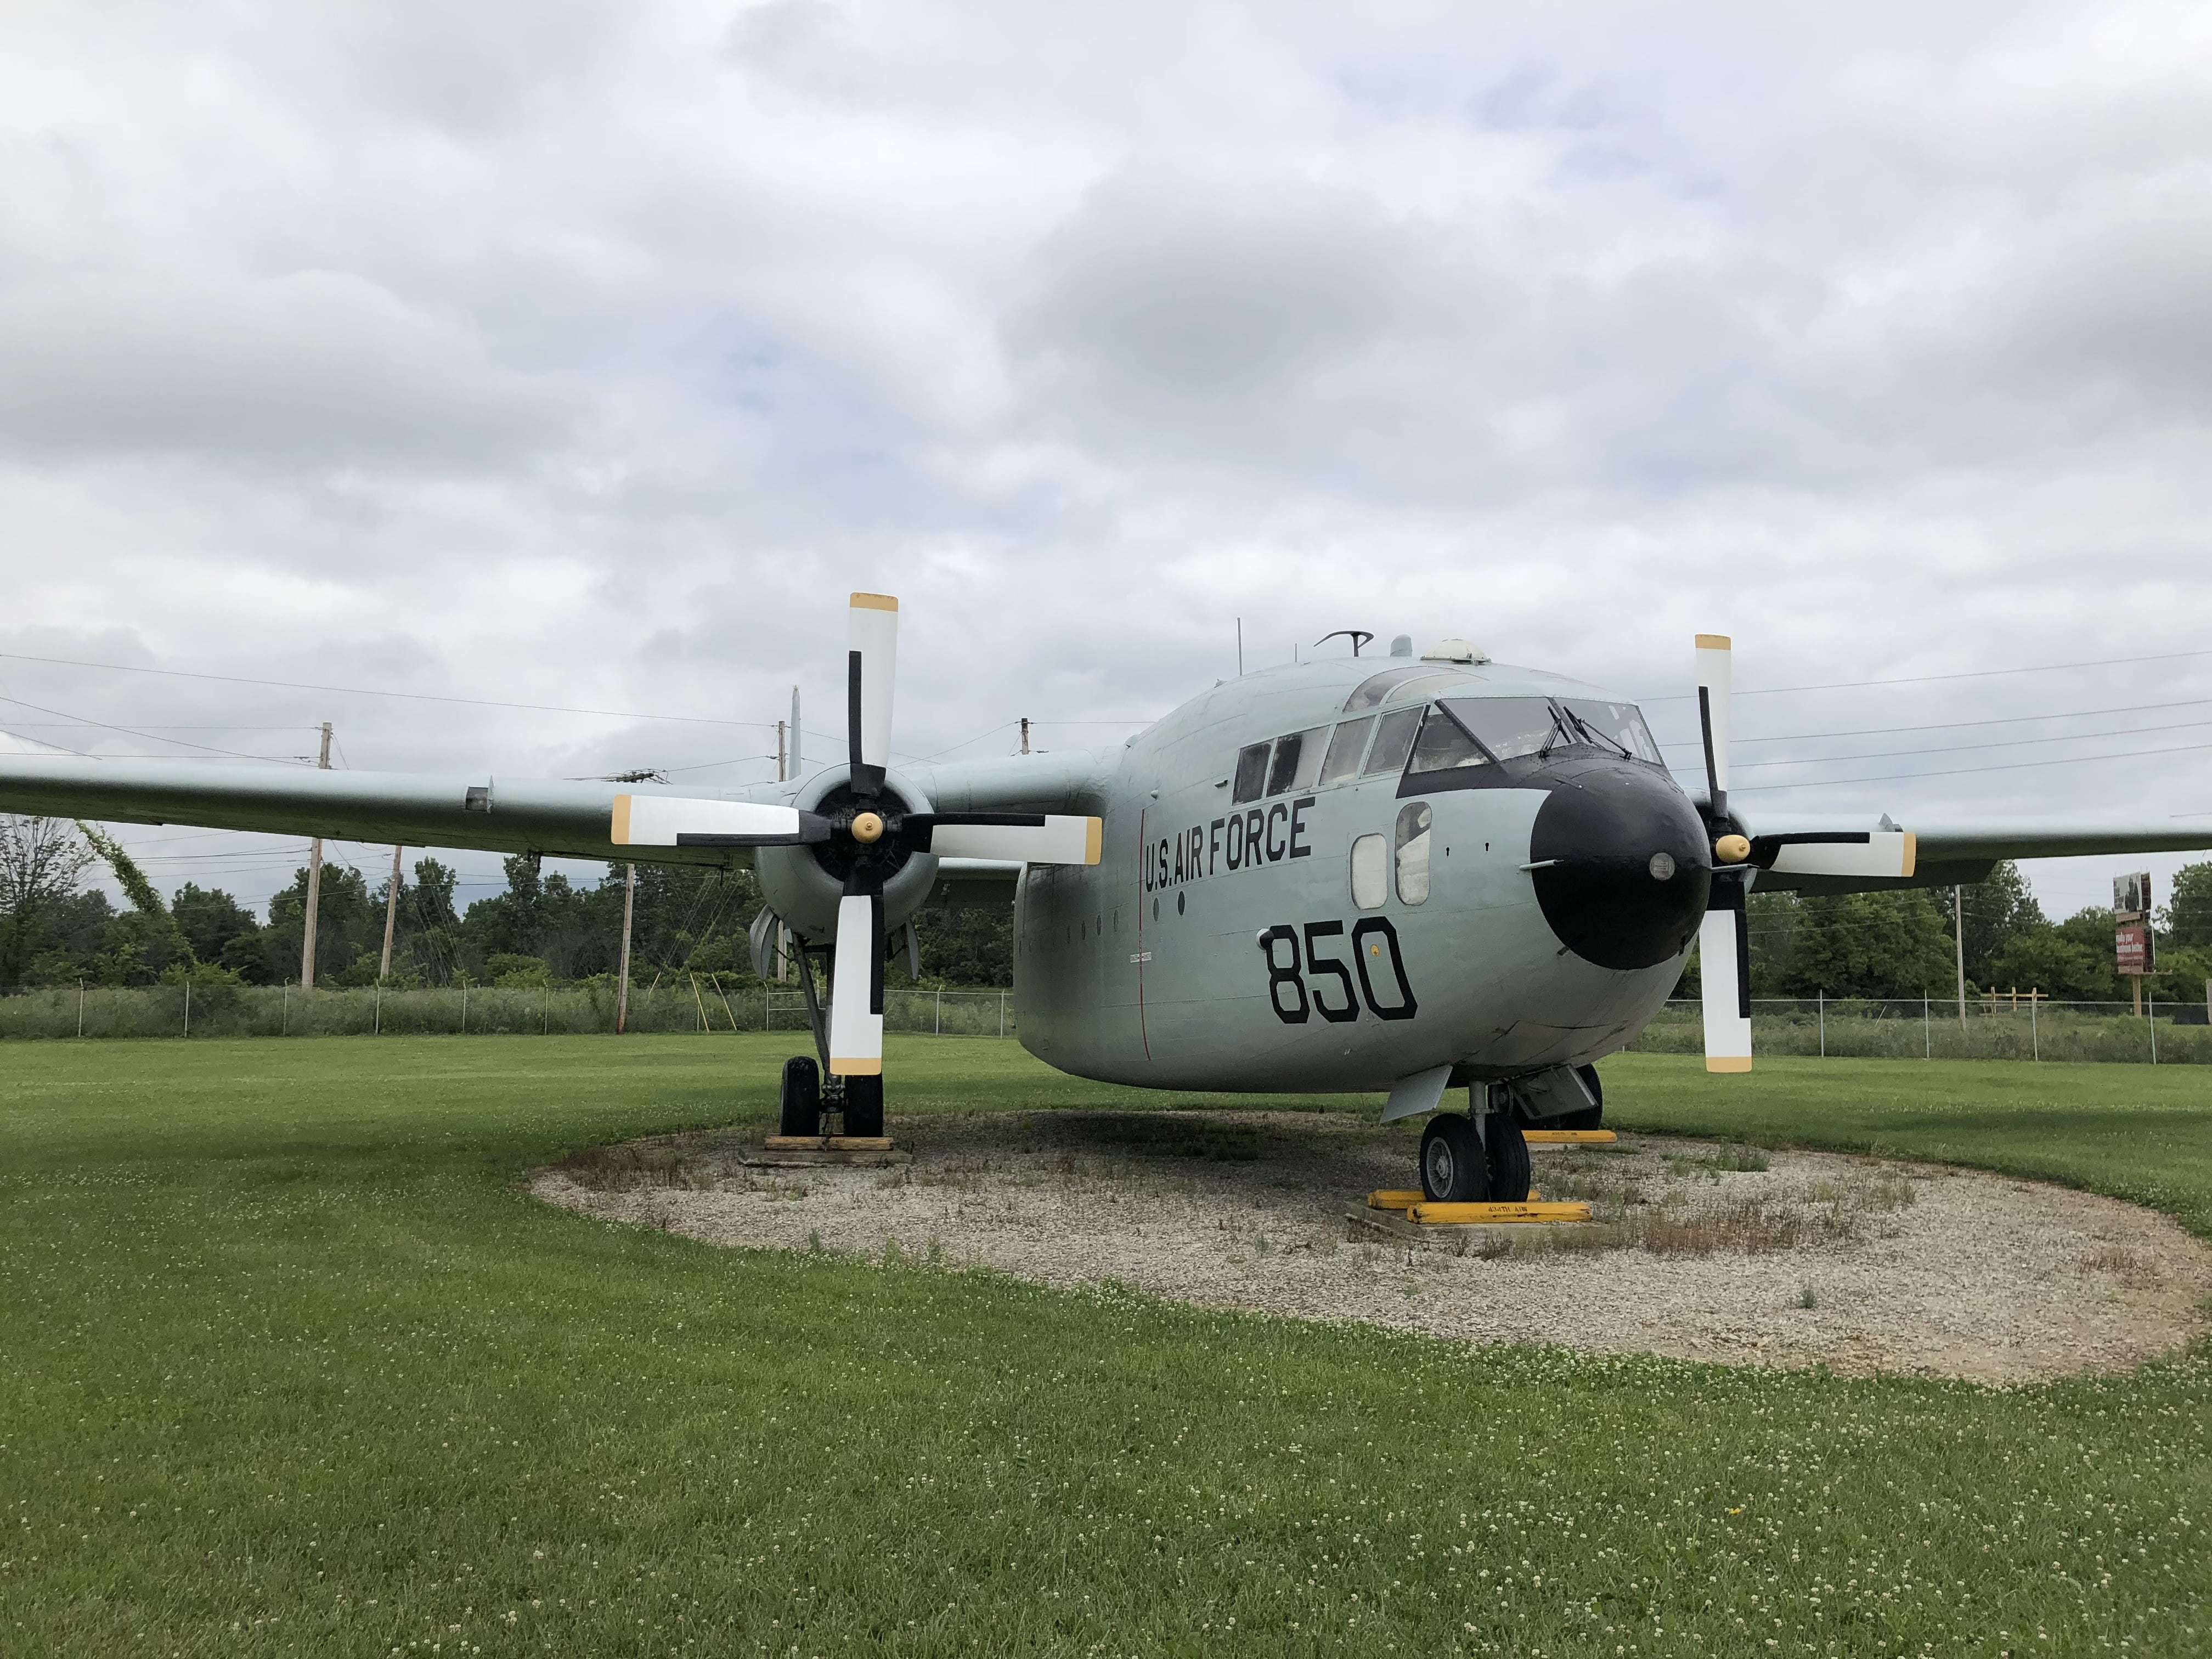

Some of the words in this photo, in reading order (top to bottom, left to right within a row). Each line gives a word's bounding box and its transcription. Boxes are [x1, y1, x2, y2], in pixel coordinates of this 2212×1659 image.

[1146, 838, 1172, 893] U.S.
[1174, 825, 1204, 885] AIR
[1209, 796, 1316, 876] FORCE
[1265, 916, 1418, 1024] 850
